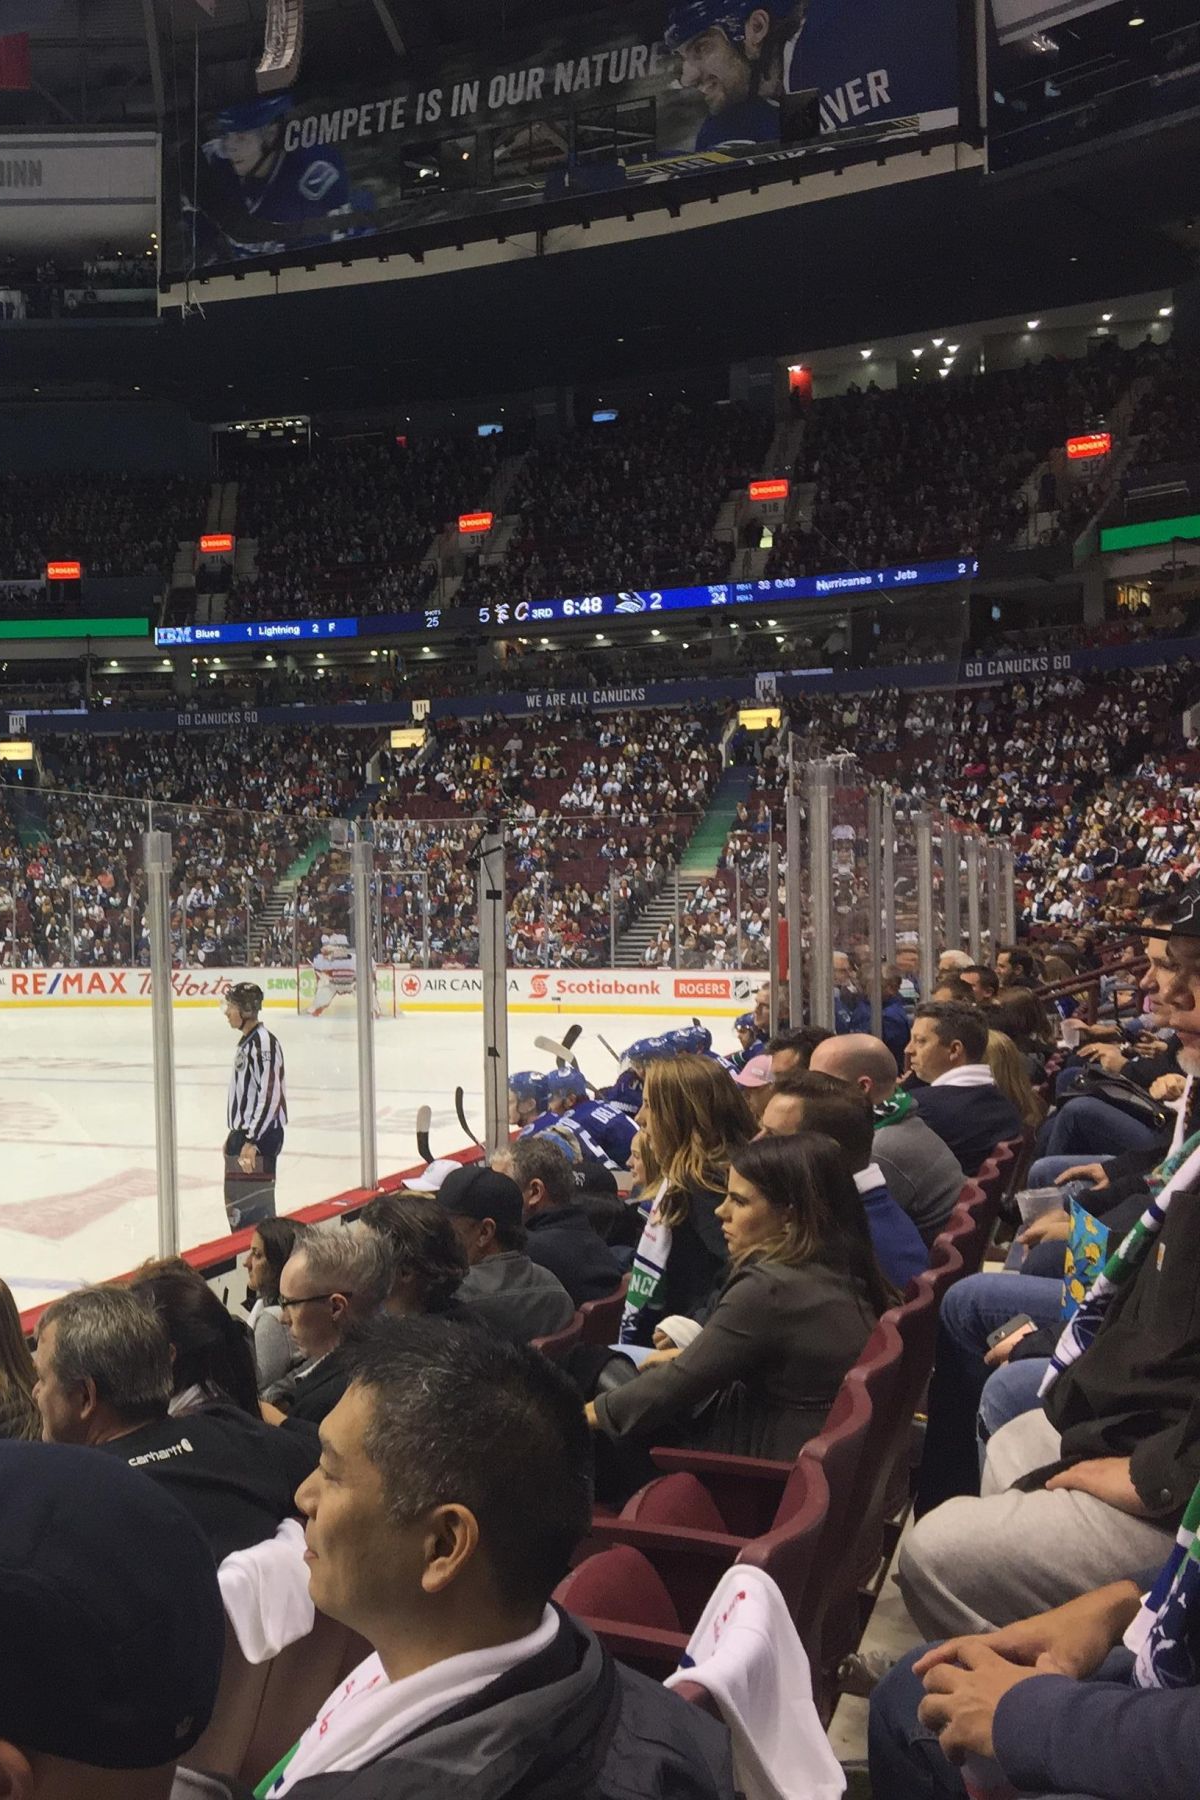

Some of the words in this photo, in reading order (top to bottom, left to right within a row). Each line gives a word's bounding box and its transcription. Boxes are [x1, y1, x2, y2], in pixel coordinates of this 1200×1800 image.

[285, 96, 407, 153] COMPETE
[416, 89, 443, 124] IS
[451, 81, 480, 117] IN
[488, 67, 545, 110] OUR
[815, 575, 872, 591] Hurricanes
[877, 573, 884, 583] 1
[894, 570, 918, 581] Jets
[958, 562, 966, 573] 2
[479, 608, 490, 622] 5
[531, 608, 554, 620] 3RD
[563, 597, 603, 616] 6:48
[650, 592, 663, 610] 2
[711, 591, 727, 604] 24
[426, 616, 440, 628] 25
[158, 627, 192, 644] IBM
[195, 629, 220, 639] Blues
[246, 627, 252, 636] 1
[259, 625, 301, 637] Lightning
[311, 623, 319, 633] 2
[965, 662, 983, 678] GO
[987, 656, 1049, 676] CANUCKS
[1053, 655, 1072, 670] GO
[525, 695, 542, 708] WE
[545, 693, 566, 706] ARE
[570, 691, 589, 705] ALL
[593, 688, 646, 703] CANUCKS
[177, 714, 191, 726] GO
[194, 711, 241, 725] CANUCKS
[244, 711, 258, 723] GO
[11, 972, 128, 995] RE/MAX
[170, 973, 233, 997] Horto
[266, 978, 297, 990] save
[424, 979, 447, 990] AIR
[450, 979, 520, 991] CANA
[556, 979, 660, 995] Scotiabank
[679, 983, 726, 994] ROGERS
[128, 1444, 183, 1467] carhartt
